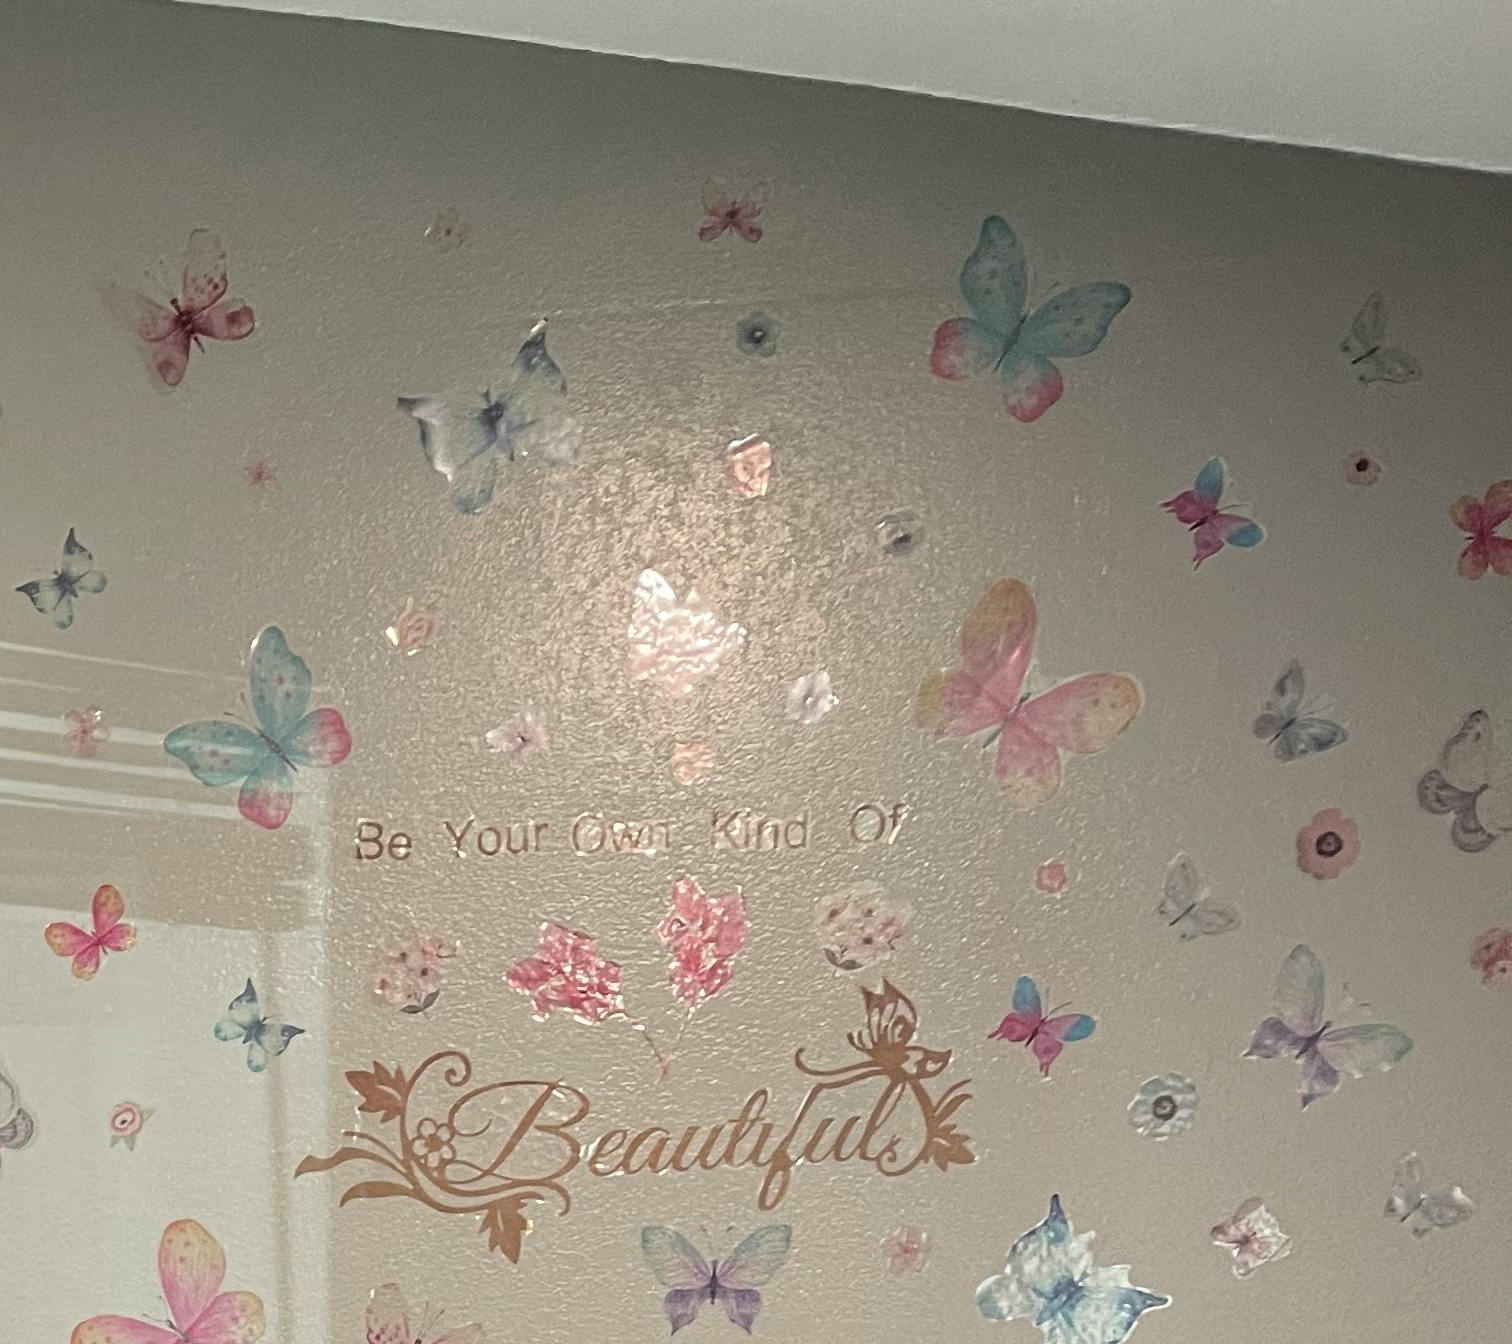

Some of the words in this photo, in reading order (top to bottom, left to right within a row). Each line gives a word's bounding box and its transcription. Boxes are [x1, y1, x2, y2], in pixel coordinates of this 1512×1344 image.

[355, 819, 412, 860] Be
[444, 816, 548, 858] Your
[572, 812, 671, 853] Own
[711, 806, 807, 850] Kind
[849, 802, 910, 845] Of
[445, 1078, 913, 1211] Beautiful
